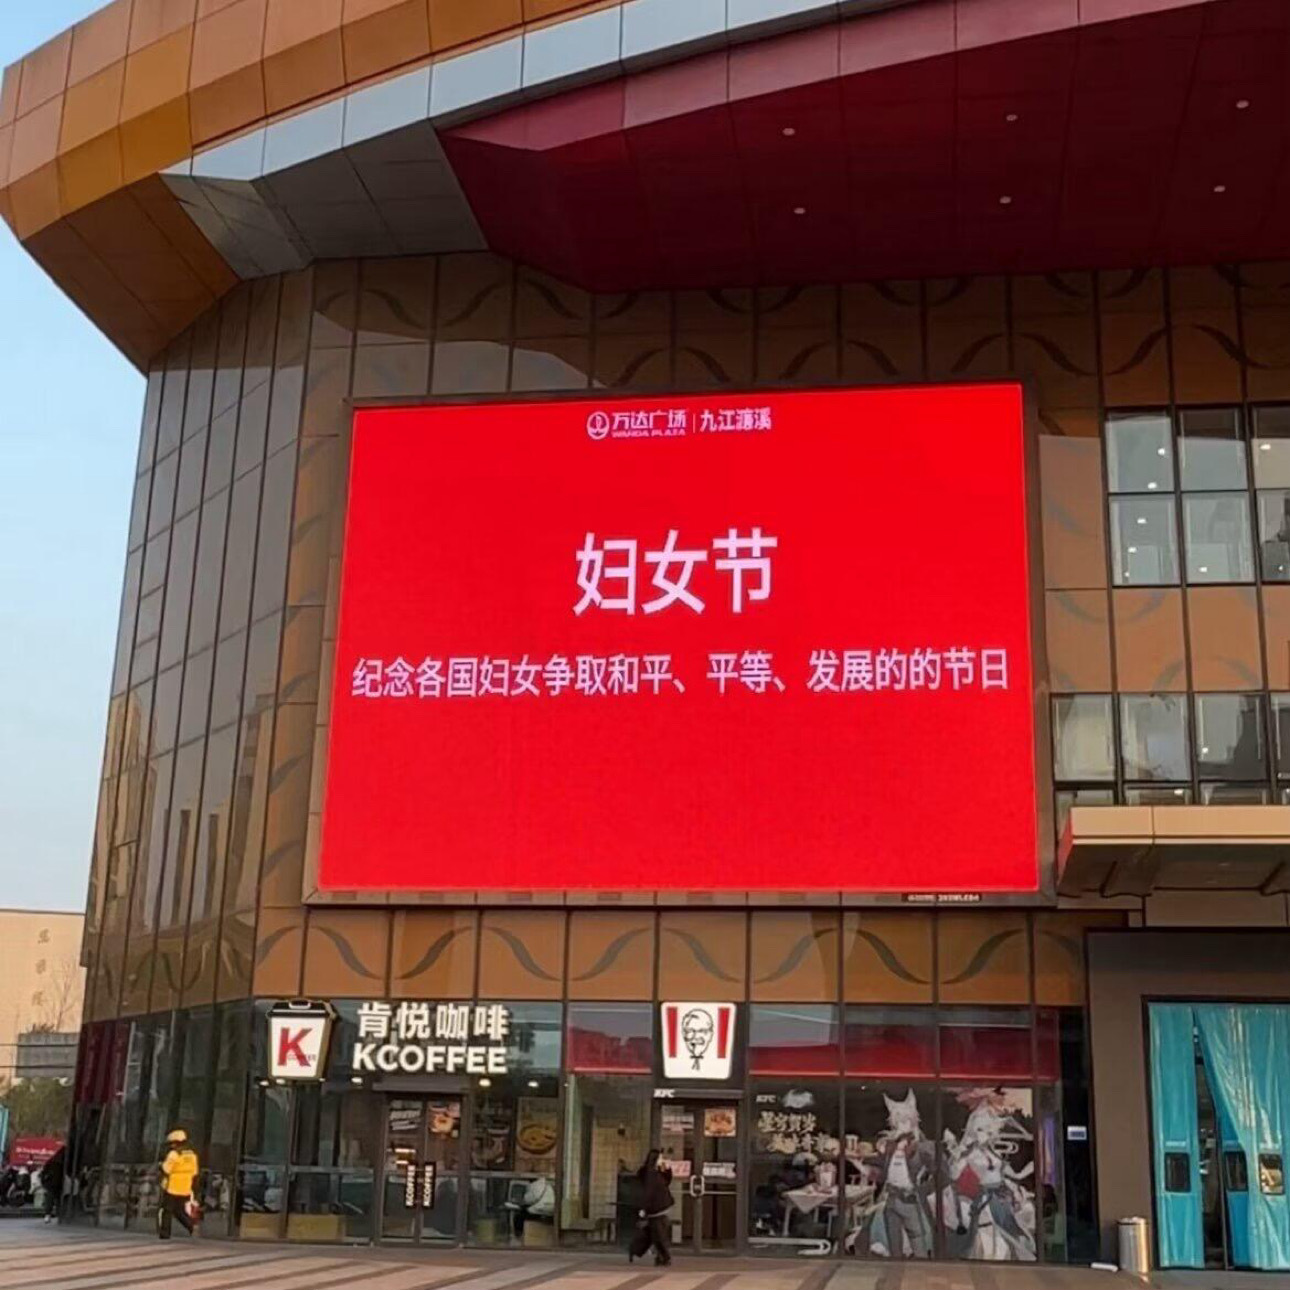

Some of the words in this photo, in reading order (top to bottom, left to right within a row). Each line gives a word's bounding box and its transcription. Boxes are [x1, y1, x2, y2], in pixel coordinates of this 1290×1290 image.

[612, 409, 688, 430] 万达广场
[573, 527, 778, 616] 妇女节
[351, 646, 1009, 699] 纪念各国妇女争取和平、平等、发展的的节日
[357, 1001, 509, 1040] 肯悦咖啡
[278, 1027, 313, 1067] K
[352, 1043, 508, 1073] KCOFFEE
